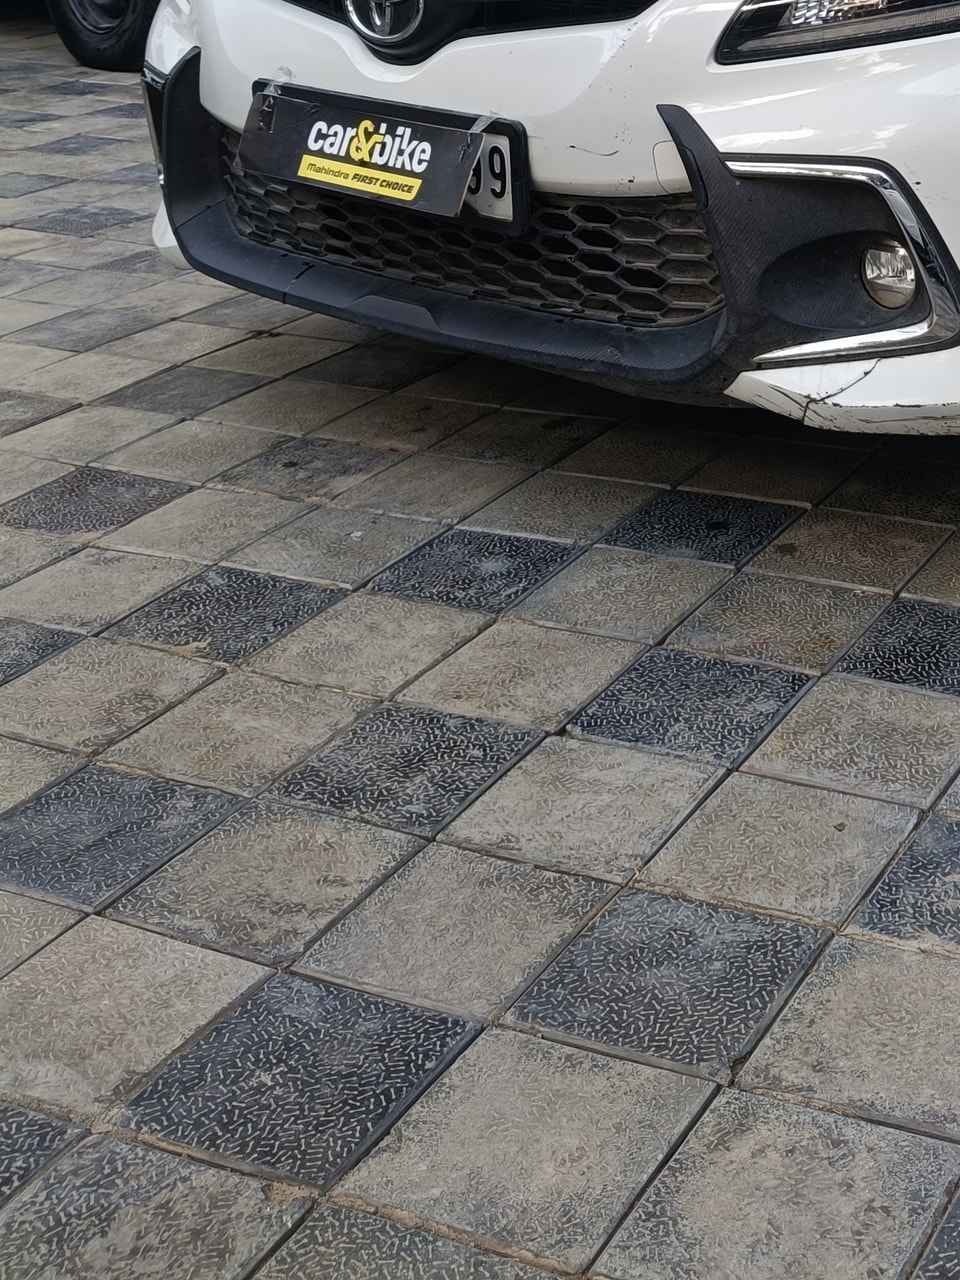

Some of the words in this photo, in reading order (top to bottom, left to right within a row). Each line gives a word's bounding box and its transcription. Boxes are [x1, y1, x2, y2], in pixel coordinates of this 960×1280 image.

[306, 119, 432, 174] car&bike
[306, 162, 351, 180] Mahindra
[350, 173, 380, 186] FIRST
[379, 179, 415, 195] CHOICE
